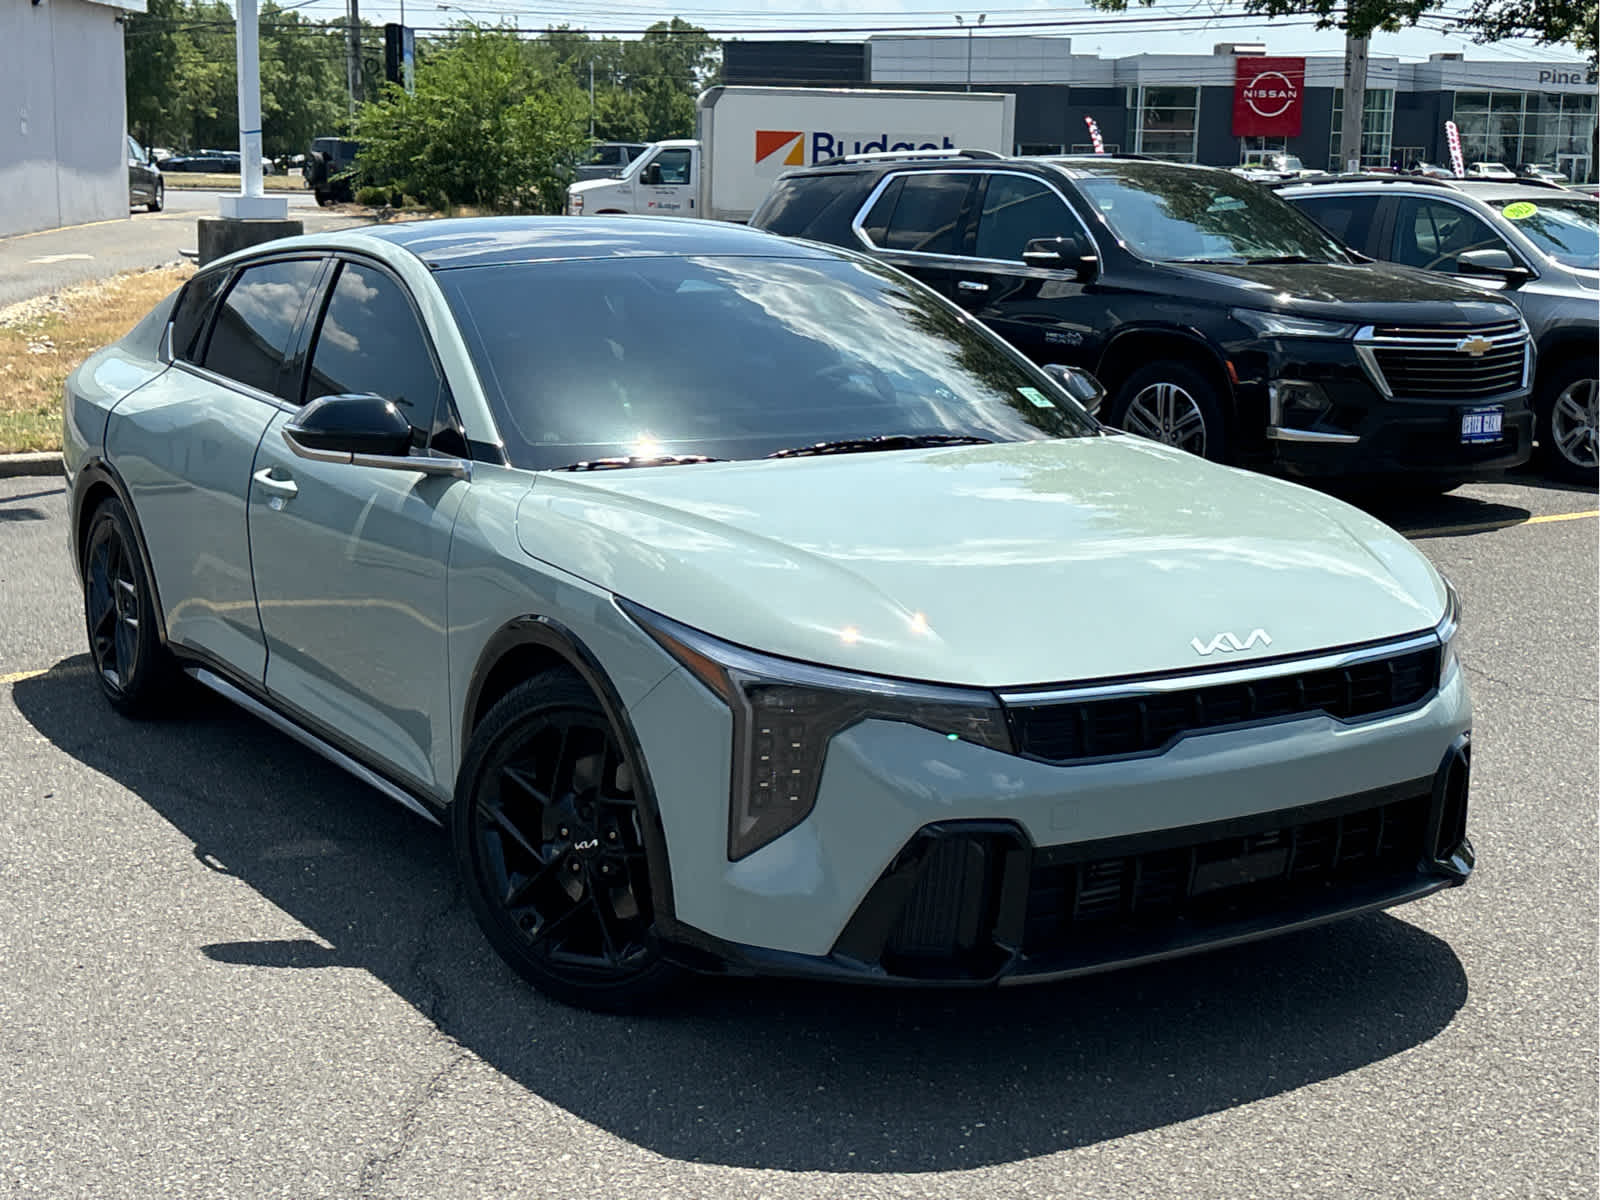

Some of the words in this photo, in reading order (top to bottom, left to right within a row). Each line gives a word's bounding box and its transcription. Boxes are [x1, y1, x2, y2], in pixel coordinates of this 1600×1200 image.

[1539, 69, 1581, 85] Pine
[1243, 89, 1297, 99] NISSAN
[1190, 628, 1272, 656] KIA
[574, 839, 598, 850] KIA
